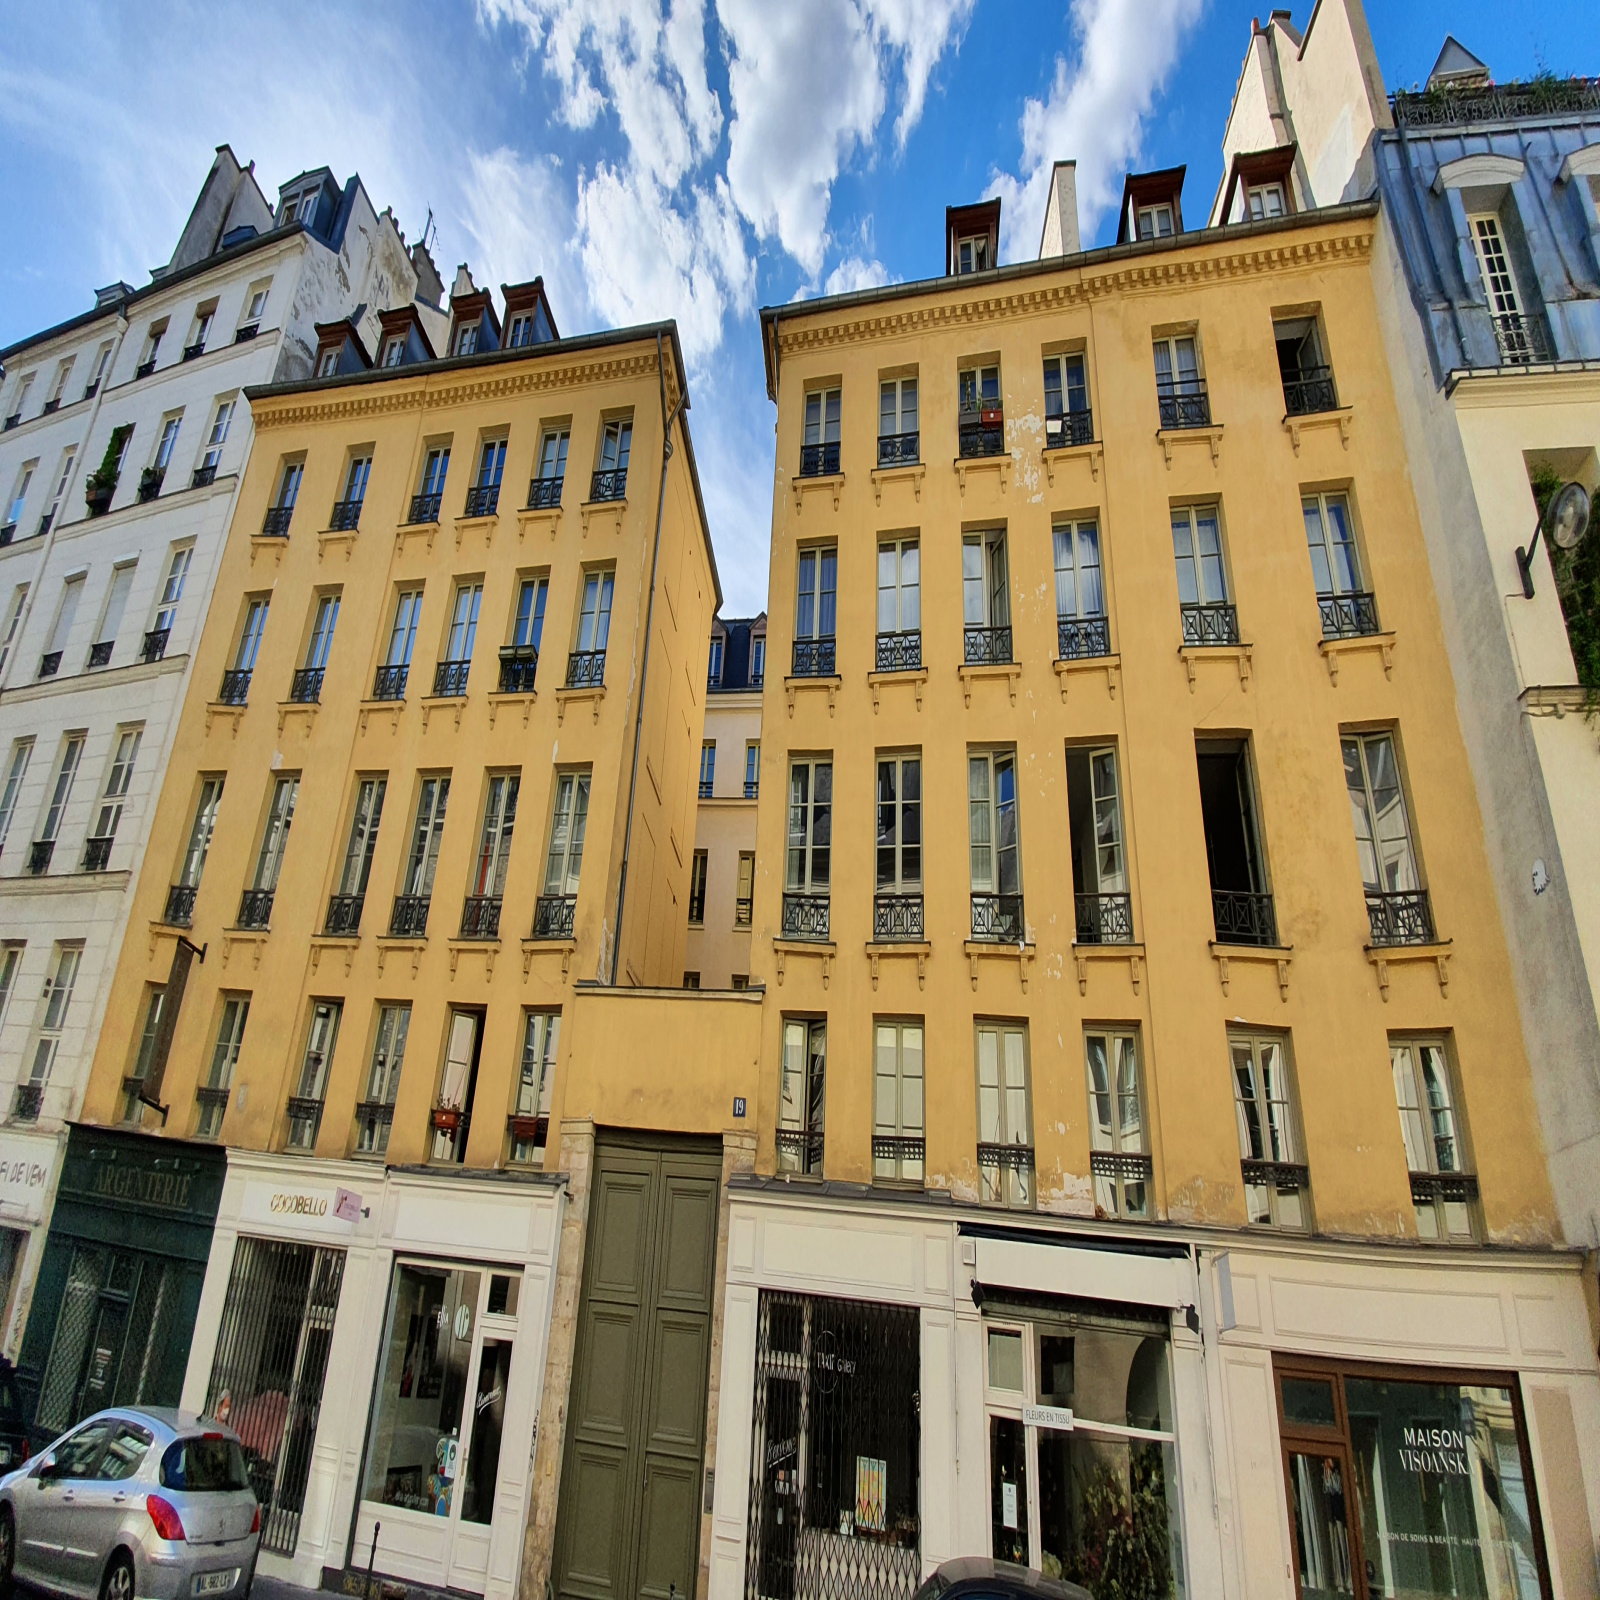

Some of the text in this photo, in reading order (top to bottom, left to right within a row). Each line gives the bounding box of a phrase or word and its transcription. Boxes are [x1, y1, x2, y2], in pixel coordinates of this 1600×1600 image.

[735, 1099, 744, 1115] 19
[10, 1162, 25, 1183] DE
[93, 1164, 192, 1207] ARGENTERIE
[270, 1193, 328, 1216] COCOBELLO
[1025, 1409, 1070, 1425] FLEURS EN TISSU
[1403, 1427, 1464, 1449] MAISON
[1400, 1532, 1409, 1542] DE
